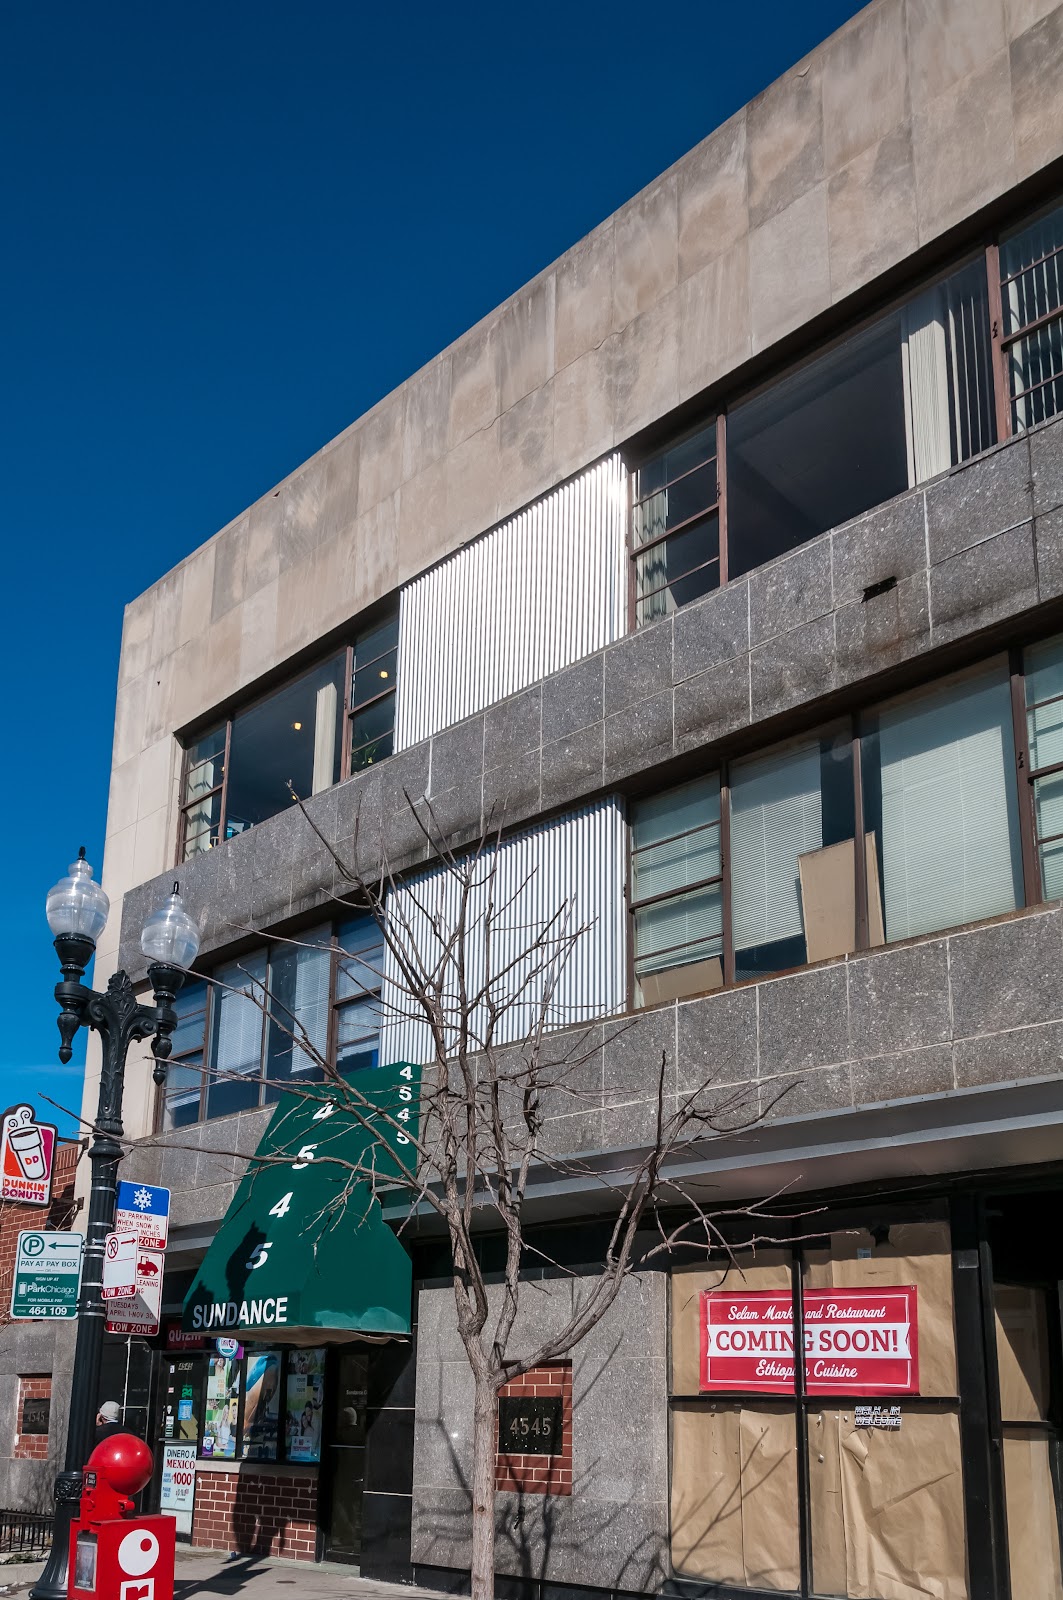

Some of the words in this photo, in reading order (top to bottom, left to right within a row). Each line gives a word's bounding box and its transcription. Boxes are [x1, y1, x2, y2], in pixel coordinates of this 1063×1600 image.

[4, 1178, 48, 1192] DUNKIN'
[1, 1187, 45, 1201] DONUTS
[128, 1212, 153, 1222] PARKING
[117, 1219, 133, 1227] WHEN
[136, 1221, 152, 1229] SNOW
[140, 1230, 161, 1238] INCHES
[140, 1238, 160, 1248] ZONE
[46, 1260, 60, 1268] PAY
[27, 1283, 76, 1295] ParkChicago
[104, 1288, 116, 1298] TOW
[117, 1286, 133, 1296] ZONE
[28, 1306, 47, 1316] 464
[49, 1307, 68, 1316] 109
[110, 1301, 139, 1310] TUESDAYS
[109, 1309, 126, 1317] APRIL
[145, 1312, 154, 1320] 30
[192, 1297, 288, 1329] SUNDANCE
[727, 1305, 760, 1320] Selam
[761, 1304, 795, 1320] Mark
[805, 1304, 825, 1319] and
[825, 1303, 887, 1319] Restaurant
[111, 1322, 128, 1332] TOW
[130, 1324, 153, 1334] ZONE
[715, 1329, 815, 1352] COMING
[819, 1329, 898, 1352] SOON!
[813, 1359, 858, 1378] Cuisine
[855, 1416, 902, 1425] WELCOME
[509, 1417, 552, 1436] 4545
[166, 1449, 190, 1459] DINERO
[190, 1450, 196, 1459] A
[166, 1459, 196, 1470] MEXICO
